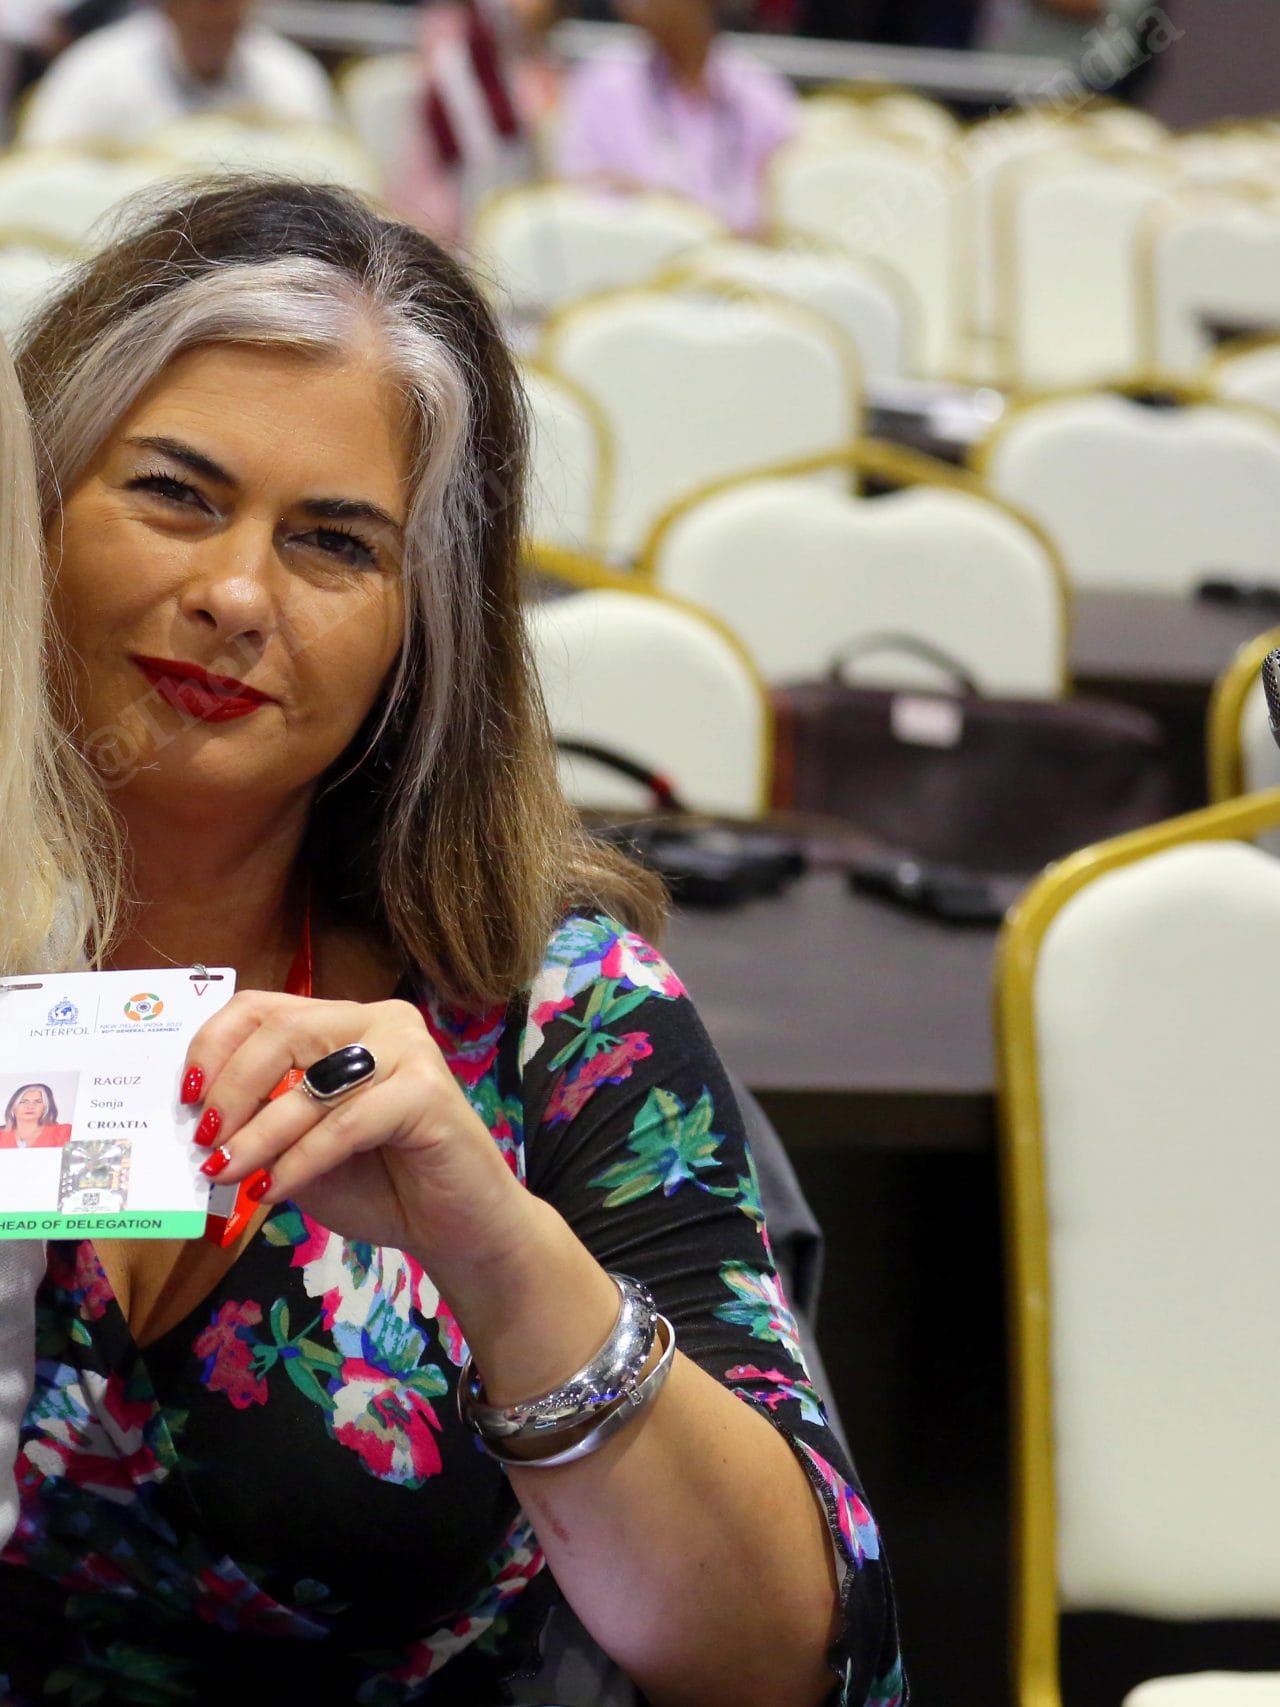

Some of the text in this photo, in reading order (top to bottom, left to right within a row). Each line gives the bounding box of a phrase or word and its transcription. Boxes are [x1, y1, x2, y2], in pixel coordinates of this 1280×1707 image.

[30, 1026, 91, 1037] INTERPOL
[93, 1076, 142, 1086] RAGUZ
[89, 1098, 124, 1110] Sonja
[87, 1120, 148, 1129] CROATIA
[41, 1220, 62, 1229] OF
[66, 1219, 162, 1229] DELEGATION
